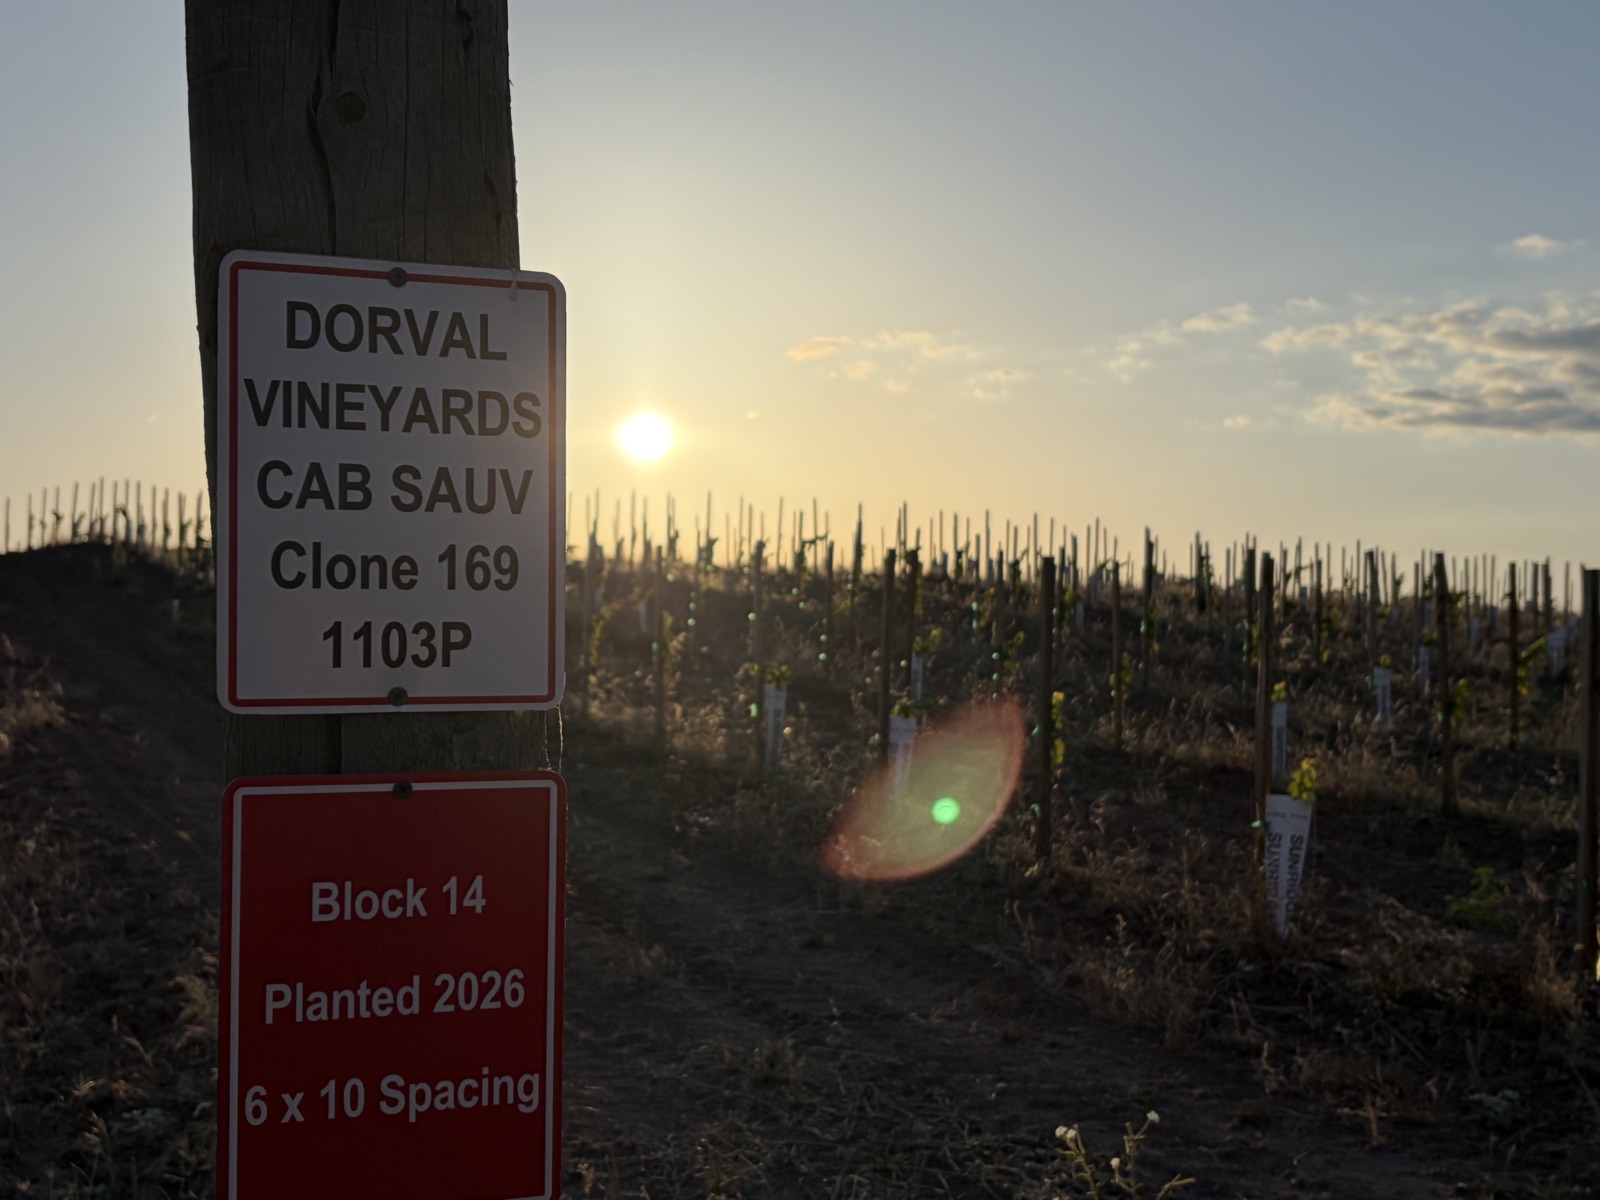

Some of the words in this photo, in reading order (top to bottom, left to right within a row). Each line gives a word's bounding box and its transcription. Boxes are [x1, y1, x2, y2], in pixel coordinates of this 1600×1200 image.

[286, 300, 507, 360] DORVAL
[243, 378, 542, 438] VINEYARDS
[256, 460, 373, 511] CAB
[390, 465, 533, 515] SAUV
[270, 541, 419, 590] Clone
[437, 544, 519, 591] 169
[322, 621, 472, 668] 1103P
[311, 879, 428, 922] Block
[441, 875, 487, 915] 14
[265, 975, 420, 1024] Planted
[433, 969, 525, 1013] 2026
[244, 1086, 268, 1126] 6
[280, 1092, 305, 1123] x
[319, 1078, 365, 1119] 10
[379, 1067, 540, 1123] Spacing
